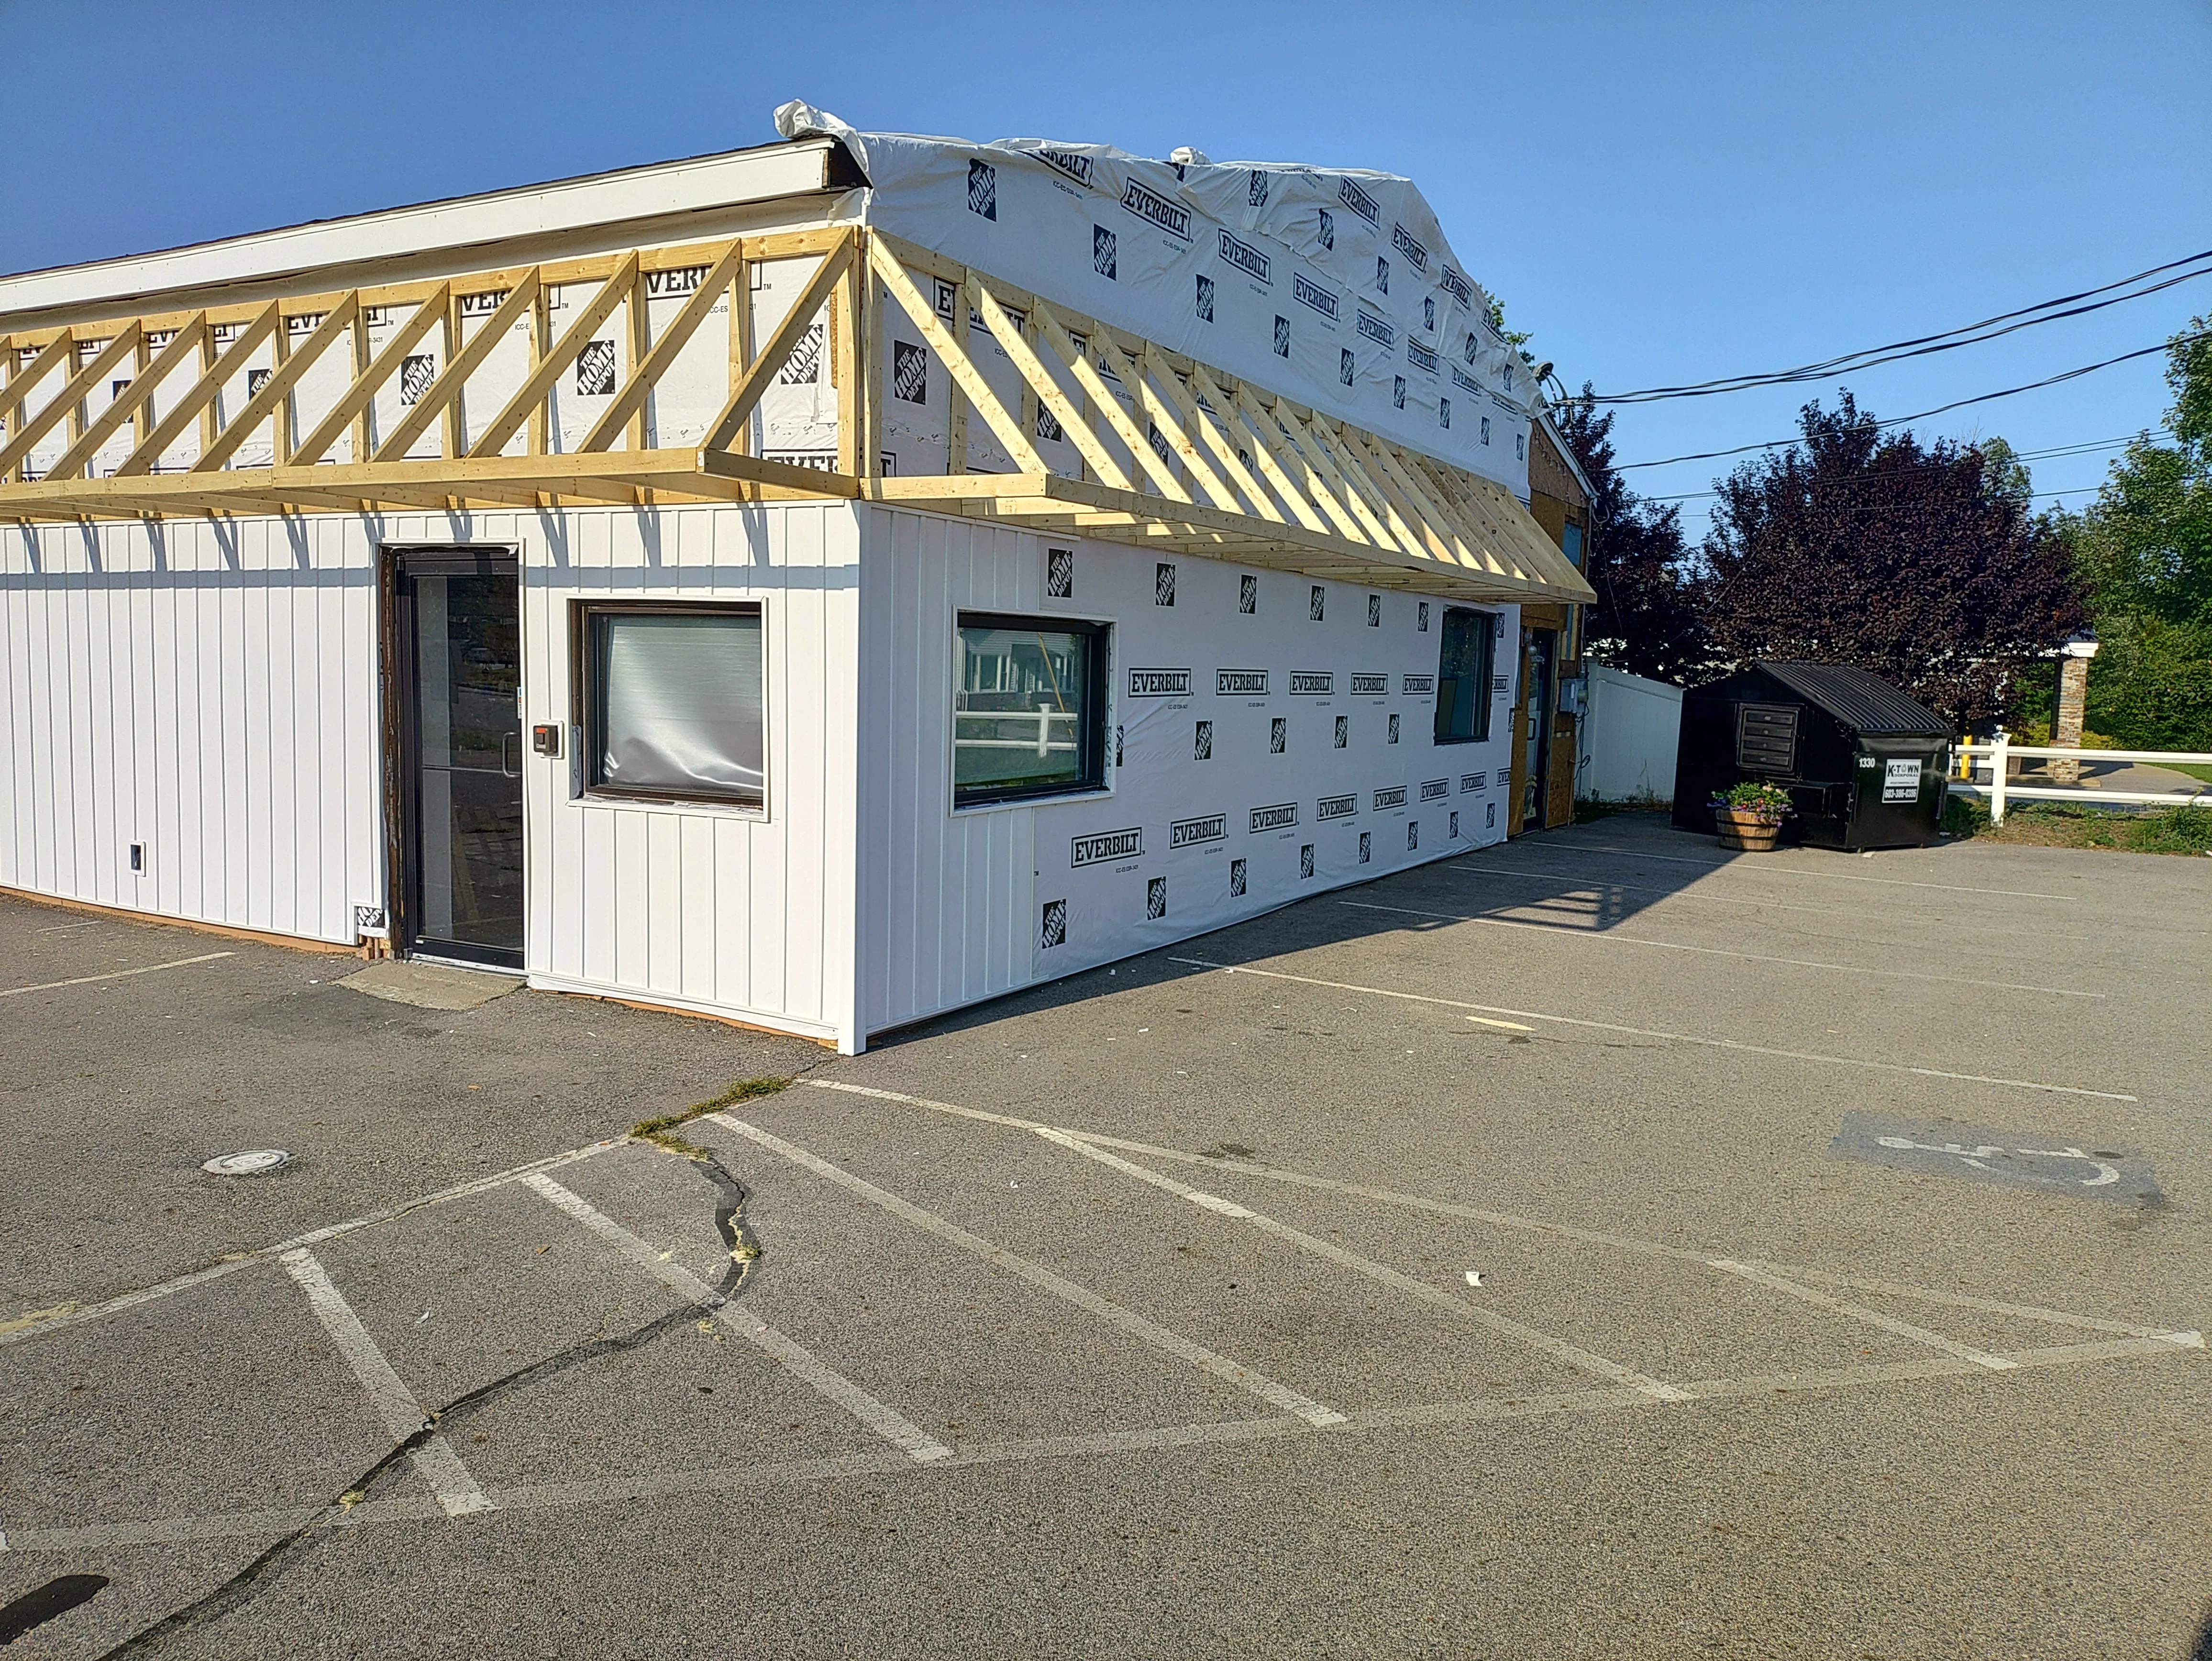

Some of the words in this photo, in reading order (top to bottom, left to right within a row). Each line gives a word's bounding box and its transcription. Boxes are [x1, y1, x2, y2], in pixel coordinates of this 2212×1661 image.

[1124, 184, 1188, 233] EVERBILT
[1341, 178, 1377, 222] EVERBILT
[1094, 232, 1117, 273] HOME
[1222, 234, 1268, 278] EVERBILT
[709, 306, 728, 314] CC-ES
[1295, 278, 1336, 316] EVERBILT
[580, 346, 597, 369] THE
[781, 324, 822, 384] HOME
[897, 349, 911, 370] THE
[401, 354, 434, 405] HOME
[404, 360, 419, 381] THE
[577, 340, 615, 396] HOME
[592, 360, 615, 395] DEPOT
[895, 347, 926, 399] HOME
[251, 374, 264, 393] THE
[906, 369, 926, 401] DEPOT
[1048, 551, 1073, 596] HOME
[1156, 565, 1175, 605] HOME
[1131, 673, 1188, 692] EVERBILT
[1218, 674, 1266, 691] EVERBILT
[1292, 675, 1331, 691] EVERBILT
[1352, 676, 1386, 691] EVERBILT
[1404, 678, 1432, 691] EVERBILT
[1859, 757, 1875, 768] 1330
[1374, 789, 1405, 807] EVERBILT
[1421, 782, 1448, 798] EVERBILT
[1252, 807, 1295, 829] EVERBILT
[1319, 797, 1355, 818] EVERBILT
[1172, 818, 1223, 844] EVERBILT
[1075, 832, 1139, 862] EVERBILT
[1042, 899, 1066, 947] HOME
